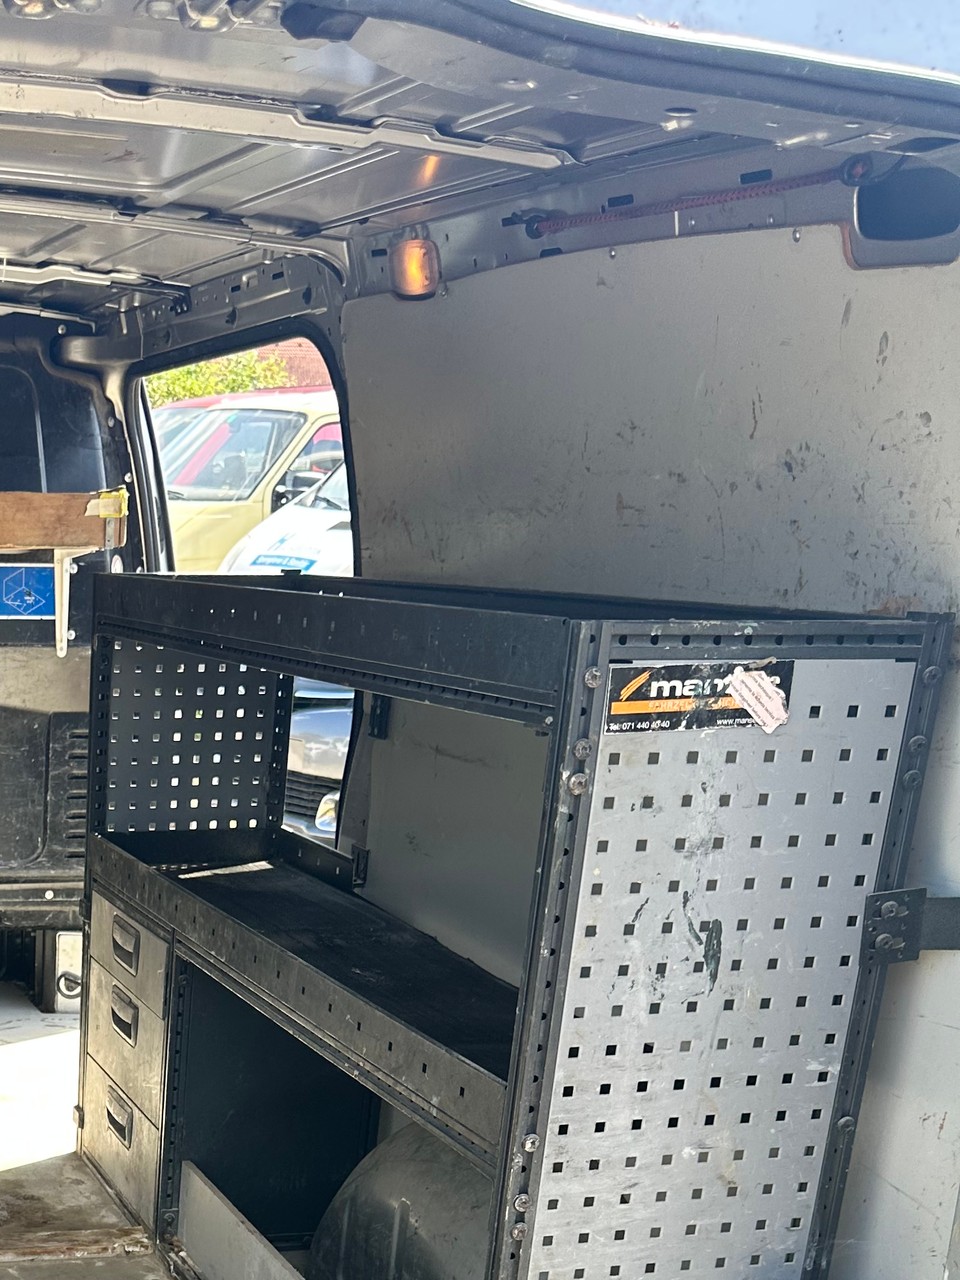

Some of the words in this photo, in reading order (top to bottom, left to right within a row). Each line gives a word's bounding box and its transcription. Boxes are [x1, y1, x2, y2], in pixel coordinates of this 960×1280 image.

[622, 722, 635, 730] 071
[636, 721, 650, 729] 440
[661, 720, 670, 728] 40
